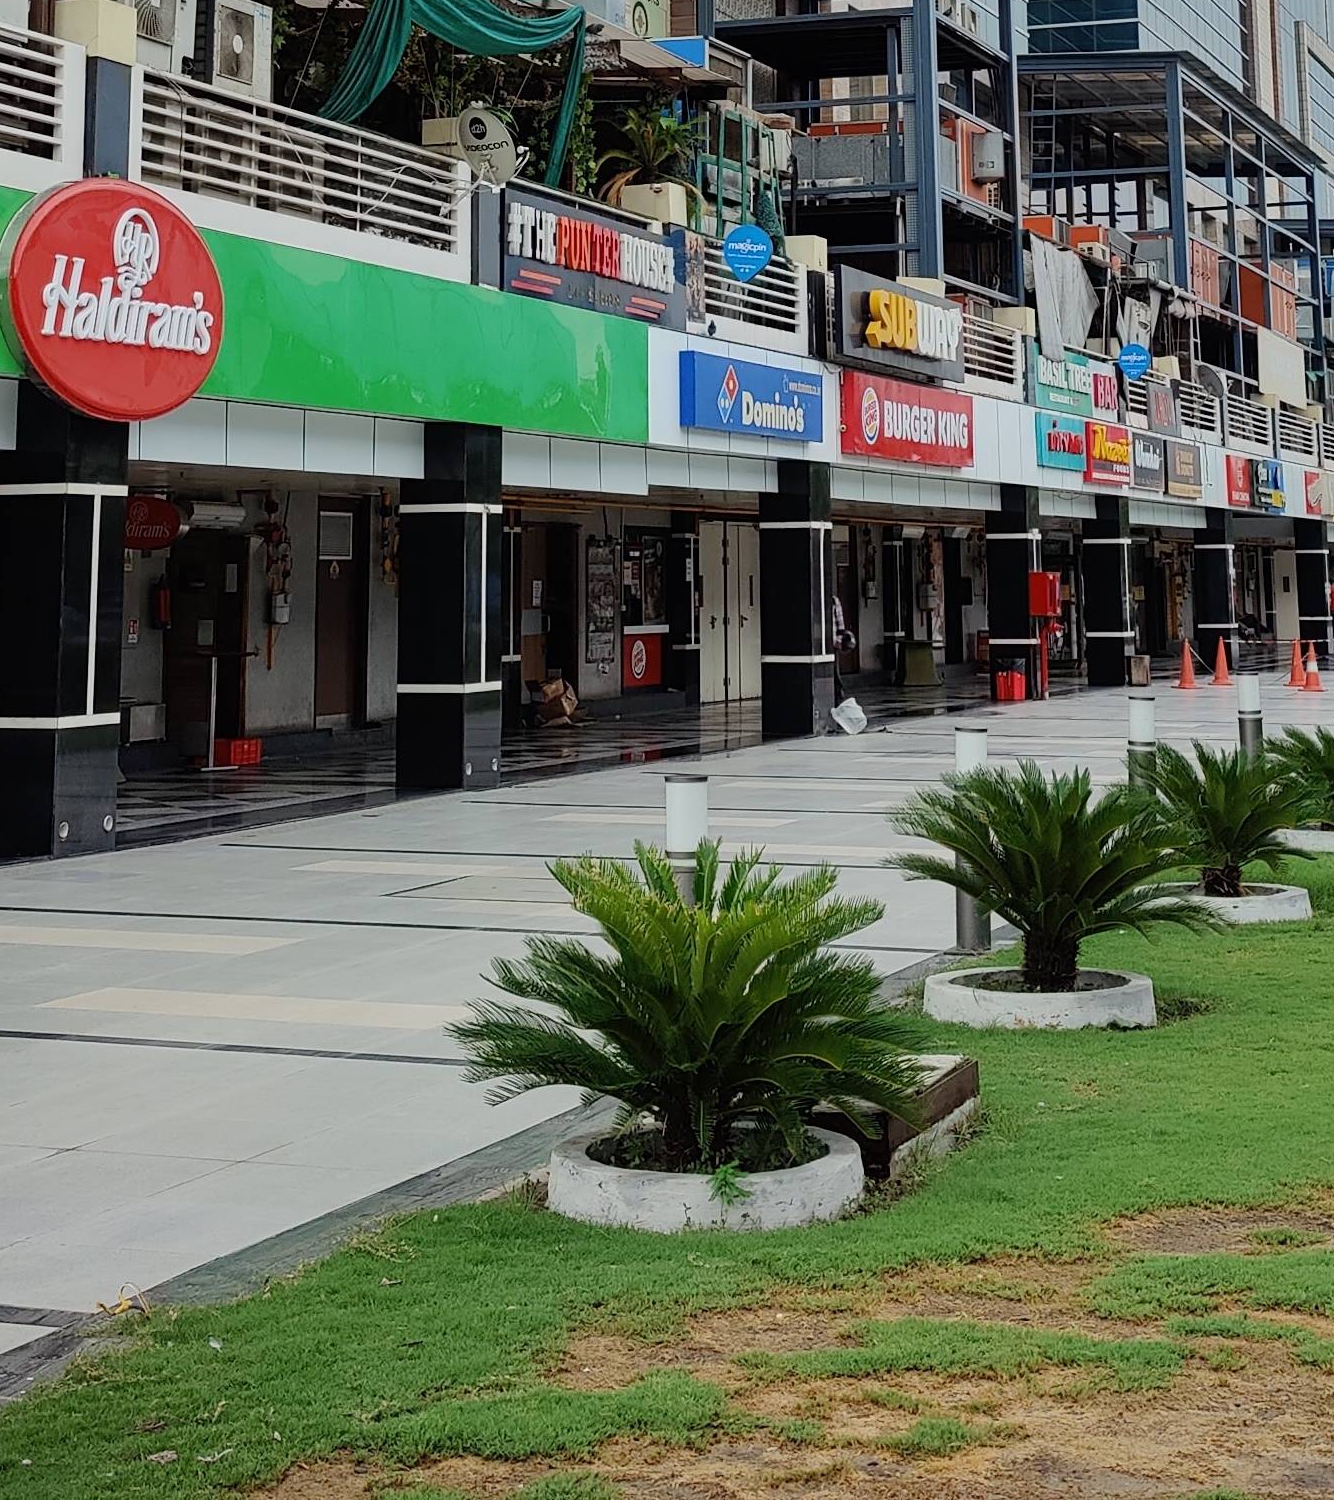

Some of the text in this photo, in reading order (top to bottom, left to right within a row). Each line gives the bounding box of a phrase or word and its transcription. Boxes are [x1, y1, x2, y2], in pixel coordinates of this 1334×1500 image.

[470, 123, 486, 134] d2h
[728, 238, 767, 254] magicpin
[41, 254, 215, 355] Haldiram's
[865, 289, 963, 362] SUBWAY
[1038, 354, 1092, 395] BASIL TREE
[1092, 373, 1118, 411] BAR
[741, 390, 805, 433] Domino's
[883, 400, 968, 449] BURGER KING
